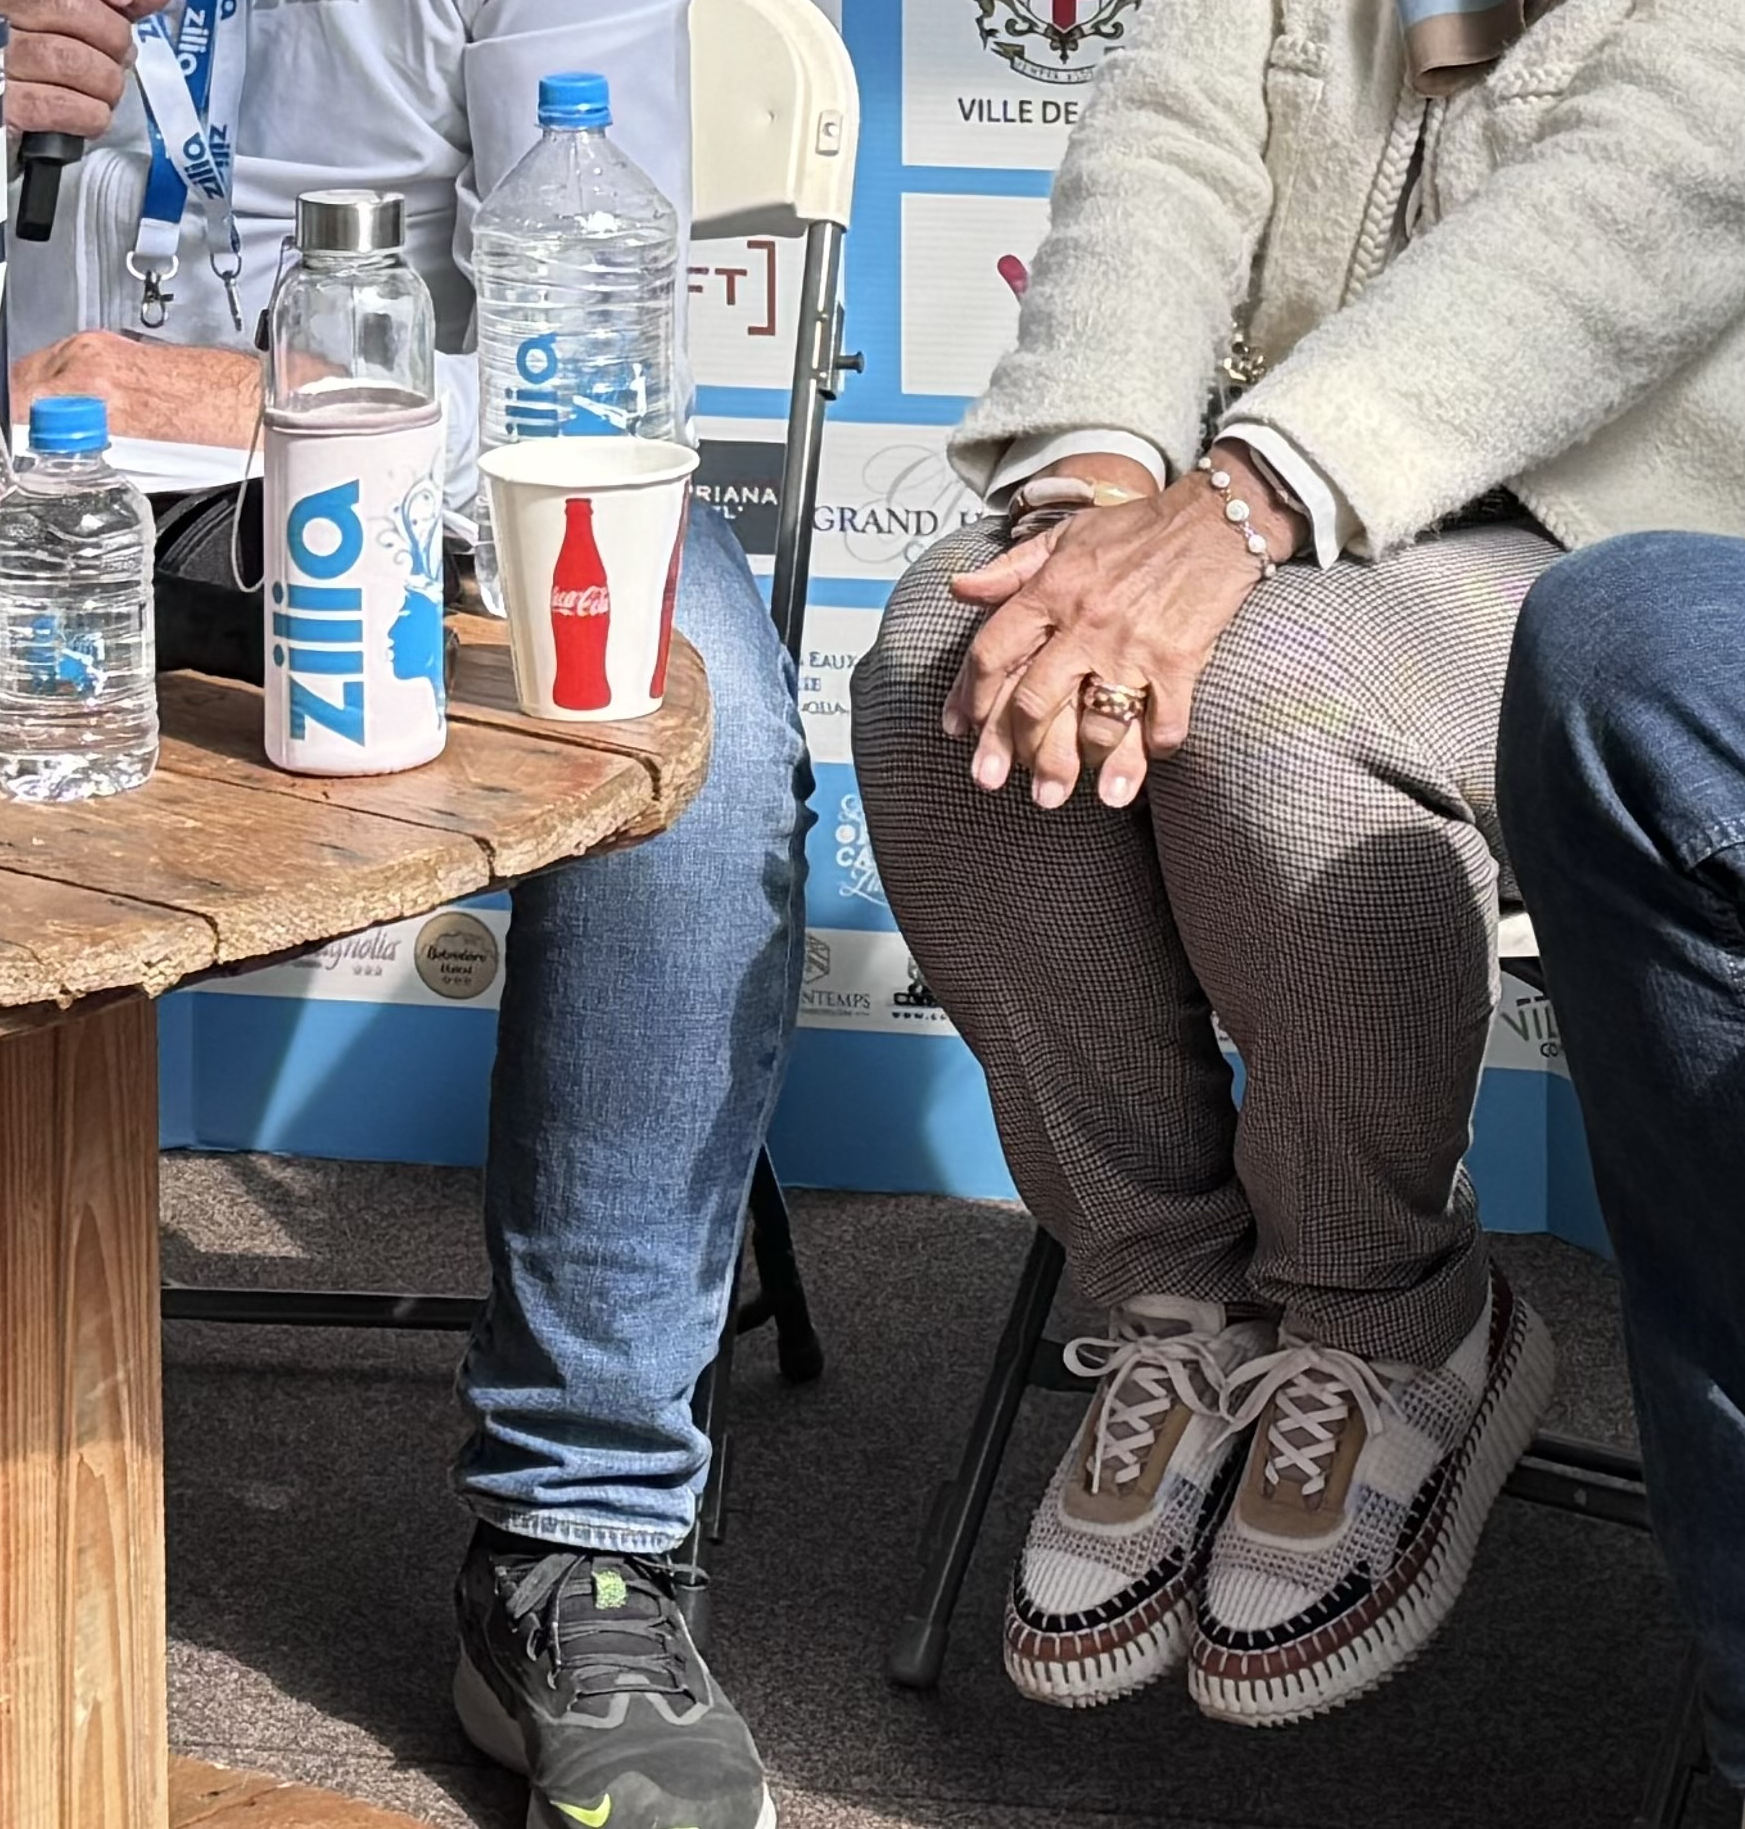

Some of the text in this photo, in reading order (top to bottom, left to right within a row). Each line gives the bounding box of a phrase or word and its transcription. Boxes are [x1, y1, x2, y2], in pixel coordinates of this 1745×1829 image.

[957, 97, 1079, 125] VILLE DE
[691, 484, 779, 506] RIANA
[813, 505, 939, 536] GRAND
[270, 477, 367, 749] zilia
